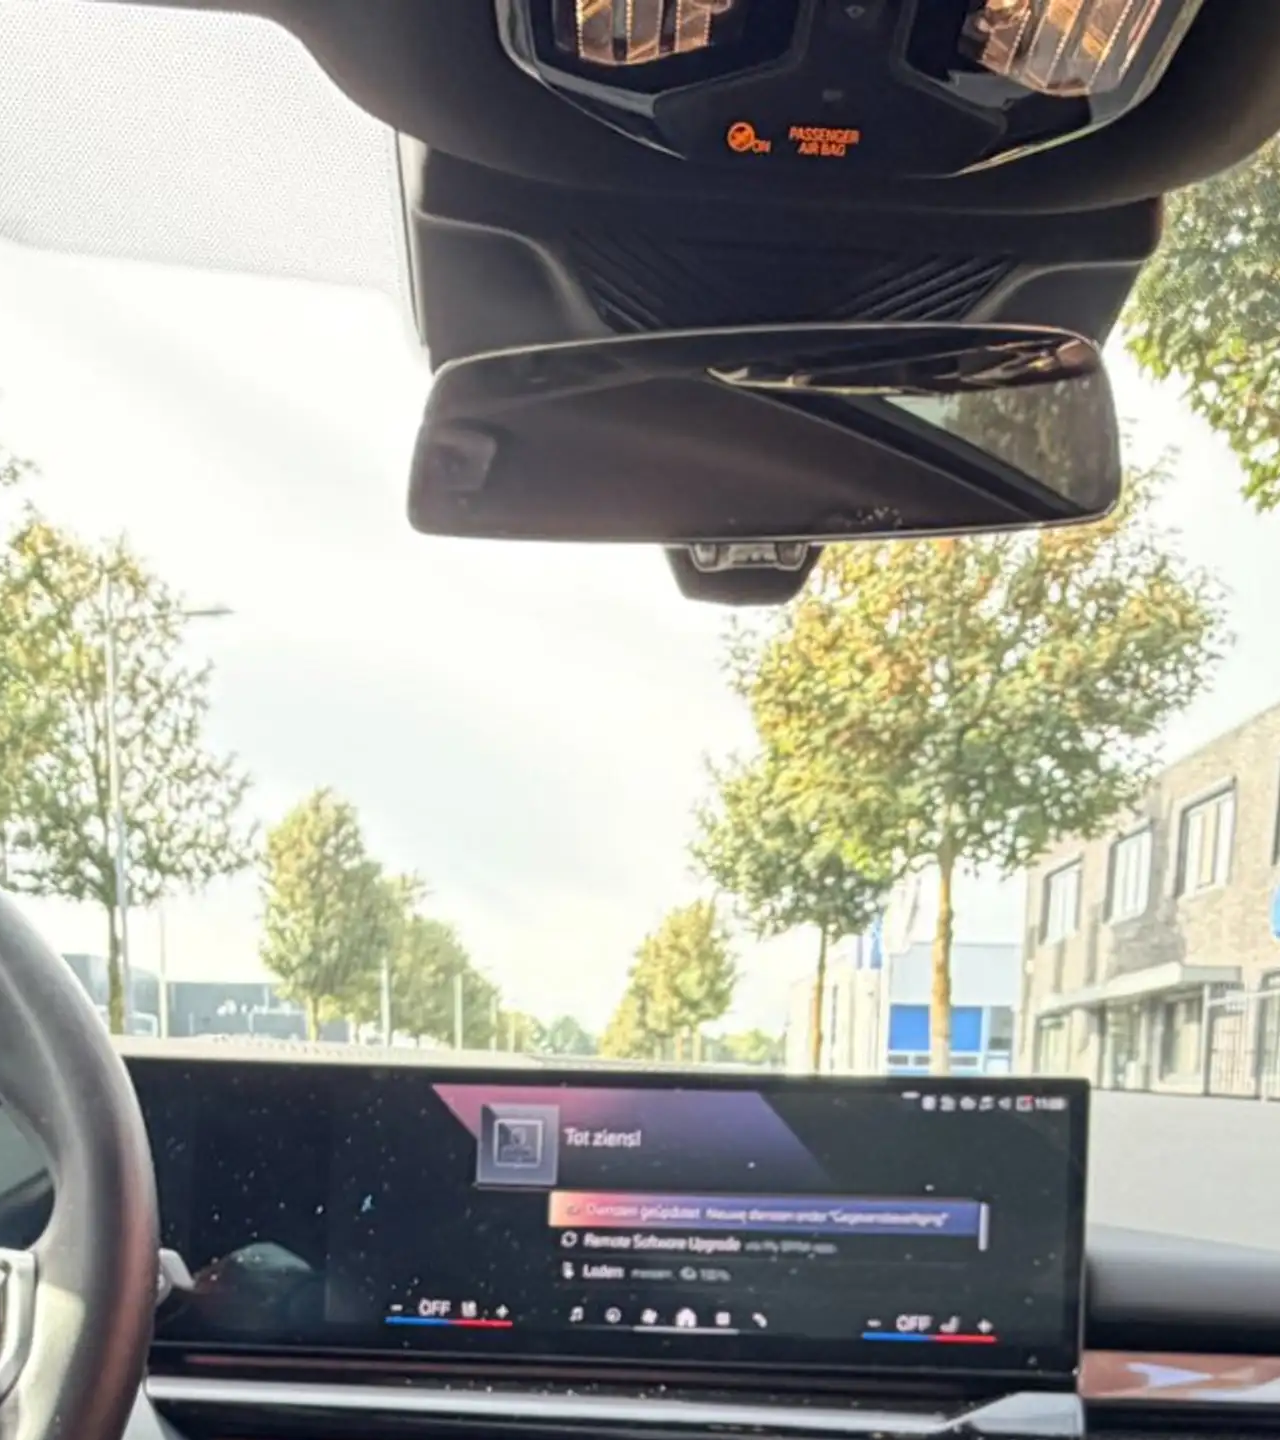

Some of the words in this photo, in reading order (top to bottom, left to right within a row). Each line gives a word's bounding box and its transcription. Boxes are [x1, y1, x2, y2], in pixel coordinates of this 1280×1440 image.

[789, 126, 860, 144] PASSENGER
[564, 1126, 590, 1147] Tot
[633, 1233, 686, 1249] Software
[419, 1299, 451, 1317] OFF
[896, 1313, 933, 1332] OFF
